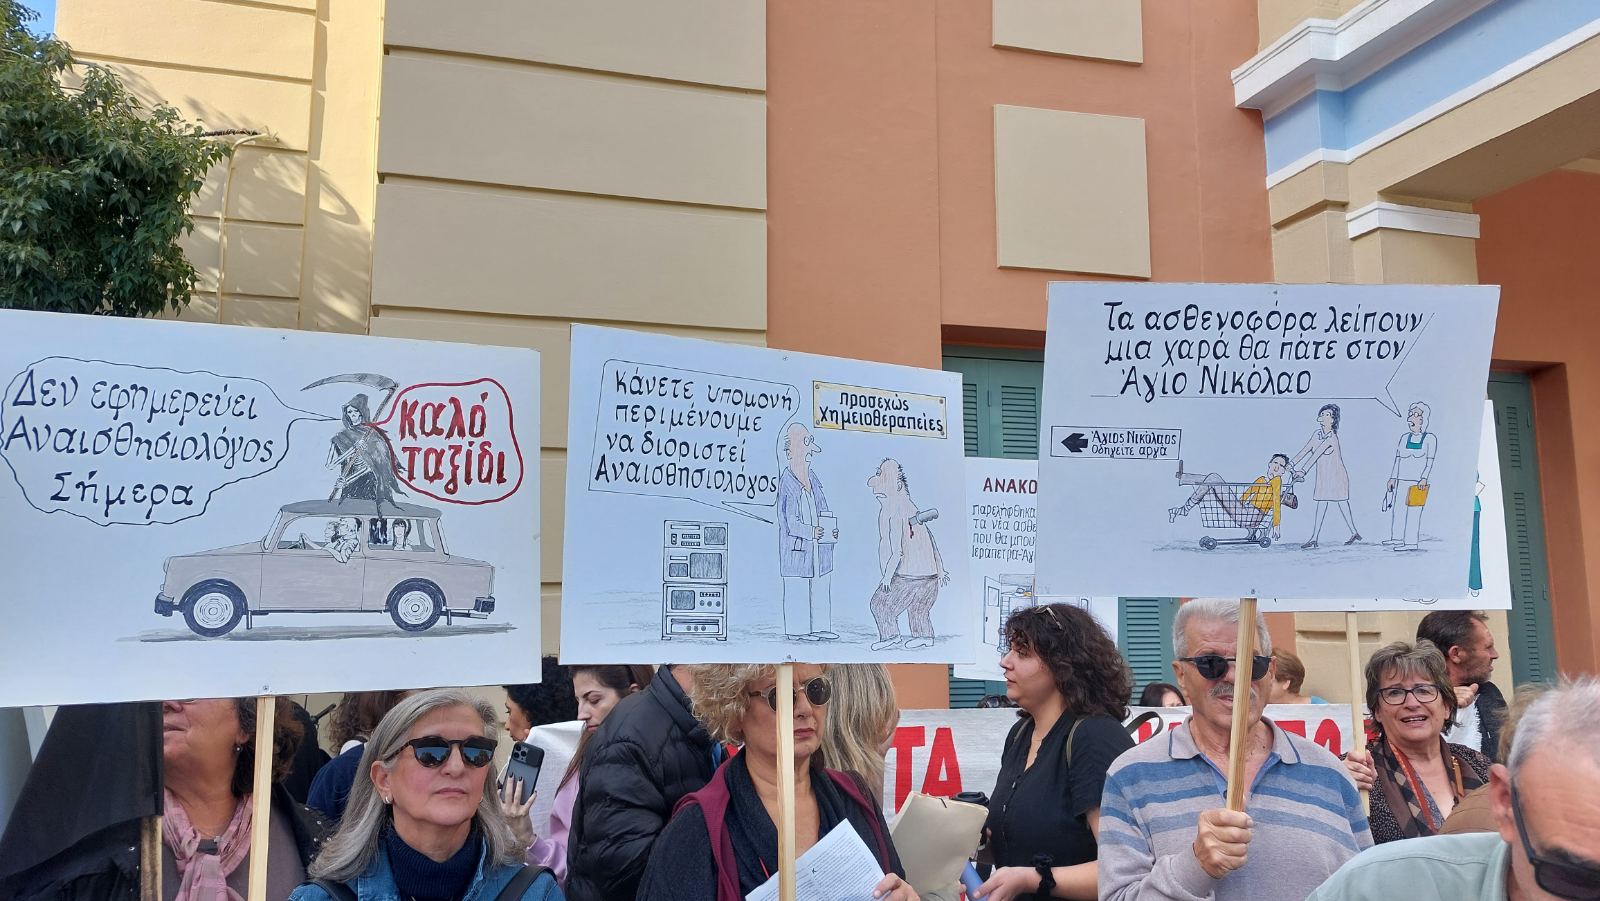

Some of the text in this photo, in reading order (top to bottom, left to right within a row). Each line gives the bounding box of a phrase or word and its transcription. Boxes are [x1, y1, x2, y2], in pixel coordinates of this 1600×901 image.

[1104, 300, 1424, 337] Τα ασθενοφόρα λείπουν
[1105, 332, 1406, 368] μια χαρά θα πάτε στον
[12, 369, 258, 426] Δεν εφημερεύει
[708, 384, 792, 413] υπομονή
[1120, 364, 1312, 403] Άγιο Νικόλαο
[615, 402, 762, 437] περιμένουμε
[1091, 430, 1177, 445] Άγιος Νικόλαος
[4, 415, 274, 469] Αναισθησιολόγος
[606, 430, 746, 463] να διοριστεί
[1138, 444, 1168, 458] αργά
[401, 440, 508, 495] ταξίδι
[594, 453, 778, 499] Αναισθησιολόγος
[50, 470, 194, 519] Σήμερα
[973, 532, 992, 544] που
[995, 531, 1008, 545] θα
[992, 516, 1009, 530] νέα
